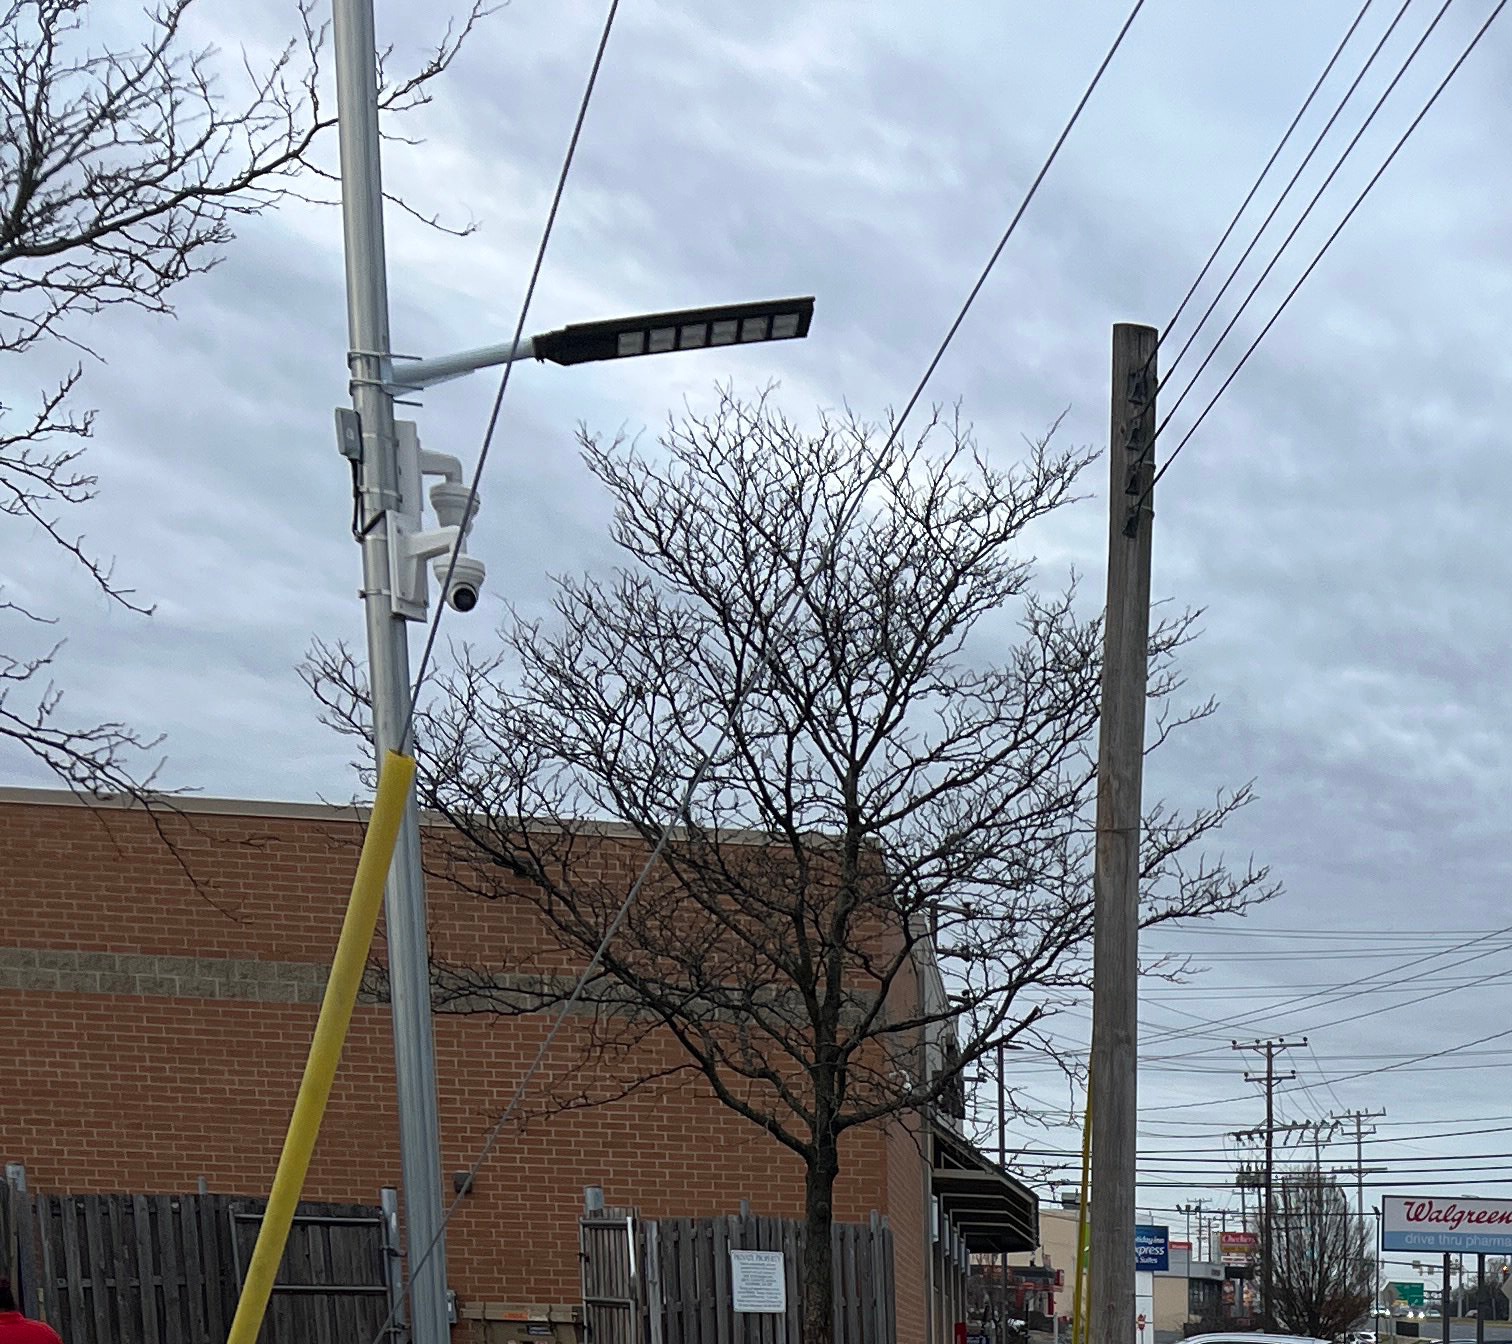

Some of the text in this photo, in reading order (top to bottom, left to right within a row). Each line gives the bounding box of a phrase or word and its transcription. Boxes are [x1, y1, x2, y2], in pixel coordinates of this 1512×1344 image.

[1405, 1233, 1434, 1245] drive
[1438, 1233, 1462, 1245] thru
[1139, 1256, 1158, 1264] Suites
